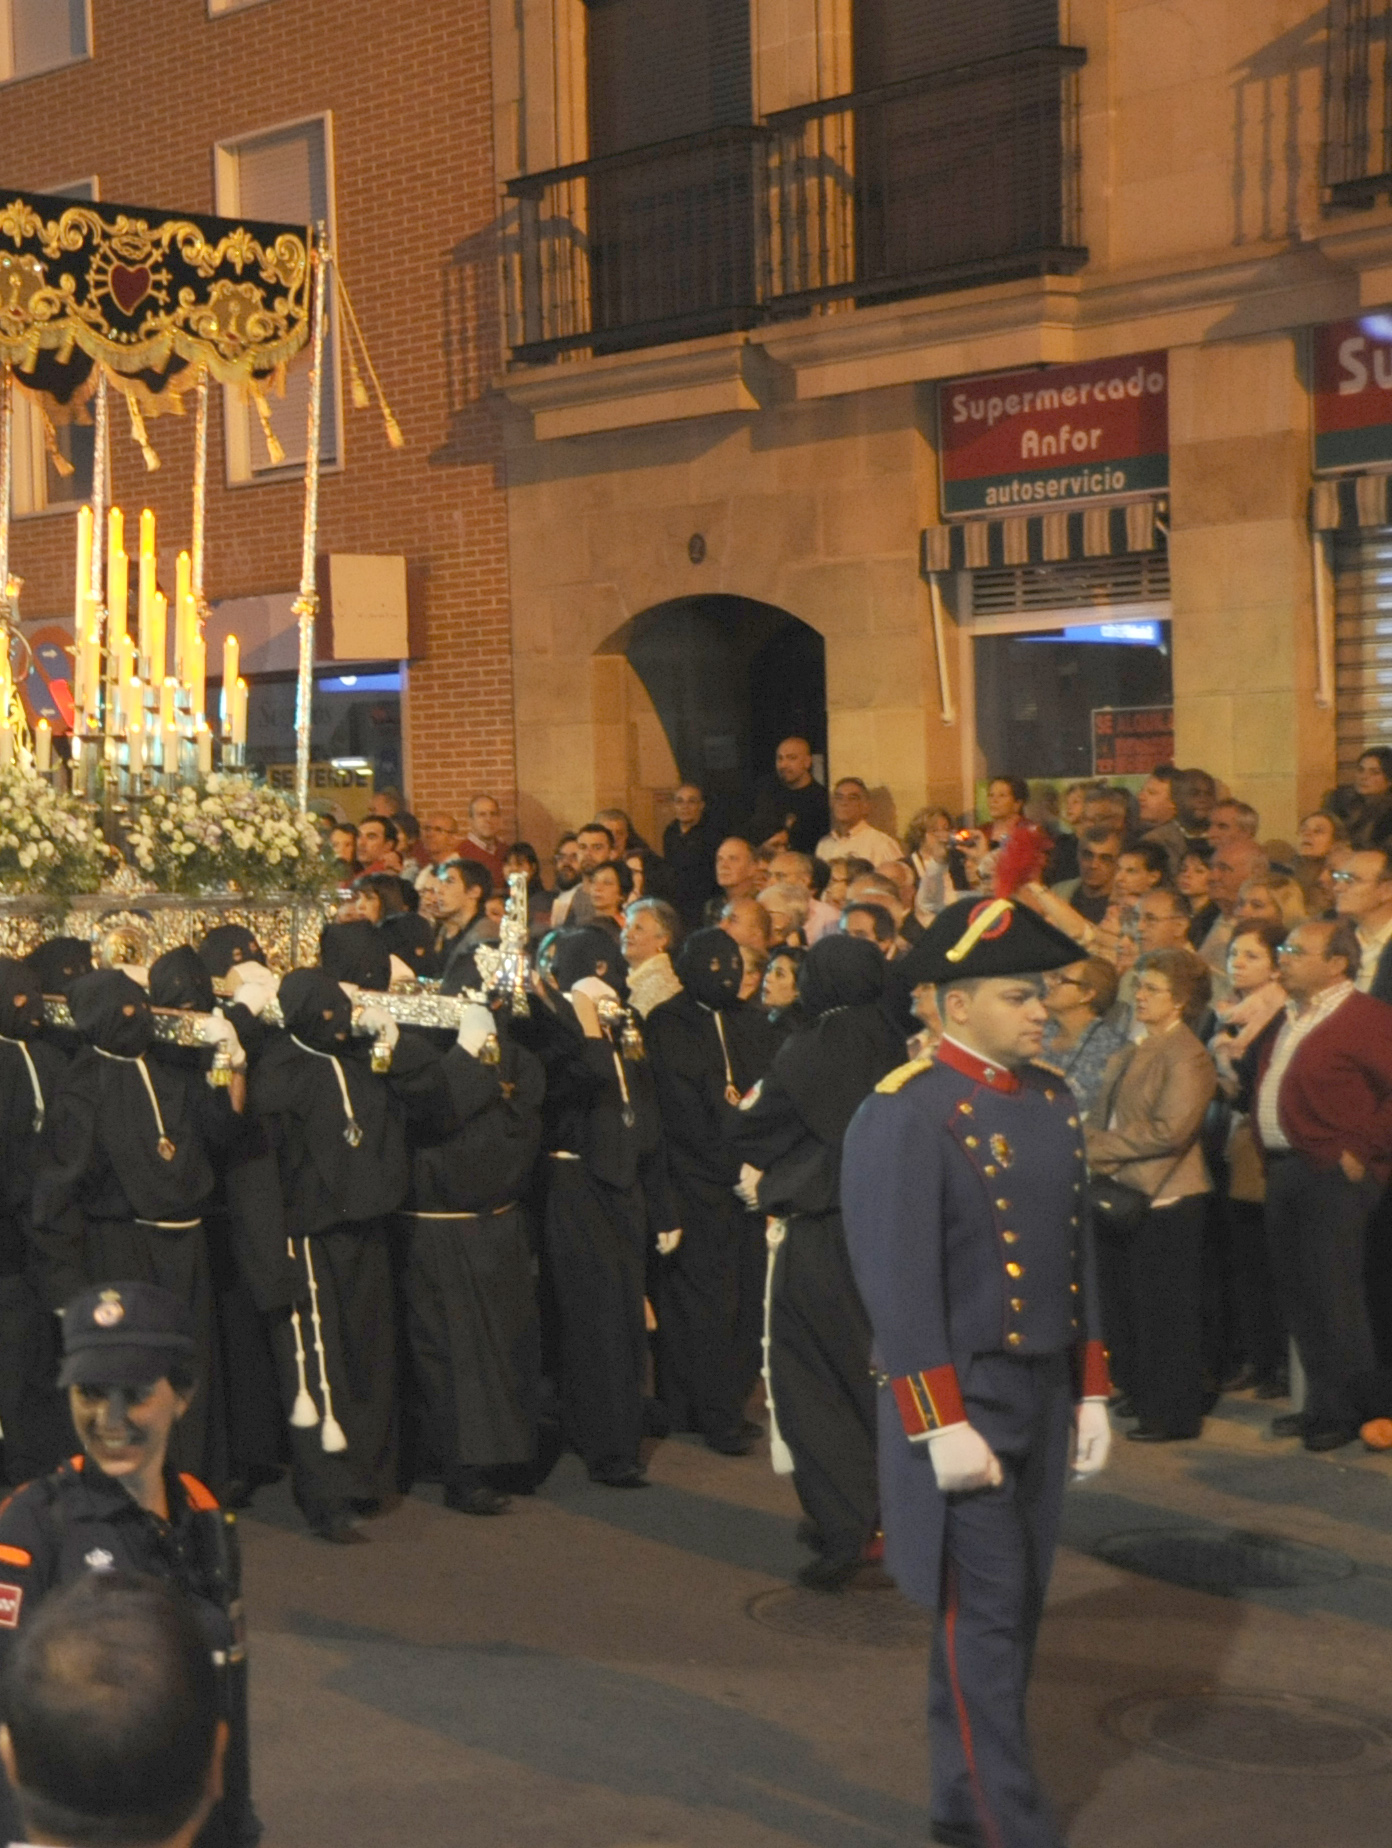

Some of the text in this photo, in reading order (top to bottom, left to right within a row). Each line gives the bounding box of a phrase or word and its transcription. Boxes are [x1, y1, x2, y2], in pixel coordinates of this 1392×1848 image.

[952, 366, 1165, 426] Supermercado
[1020, 424, 1103, 459] Anfor
[985, 466, 1126, 506] autoservicio
[272, 767, 368, 789] SE ENDE
